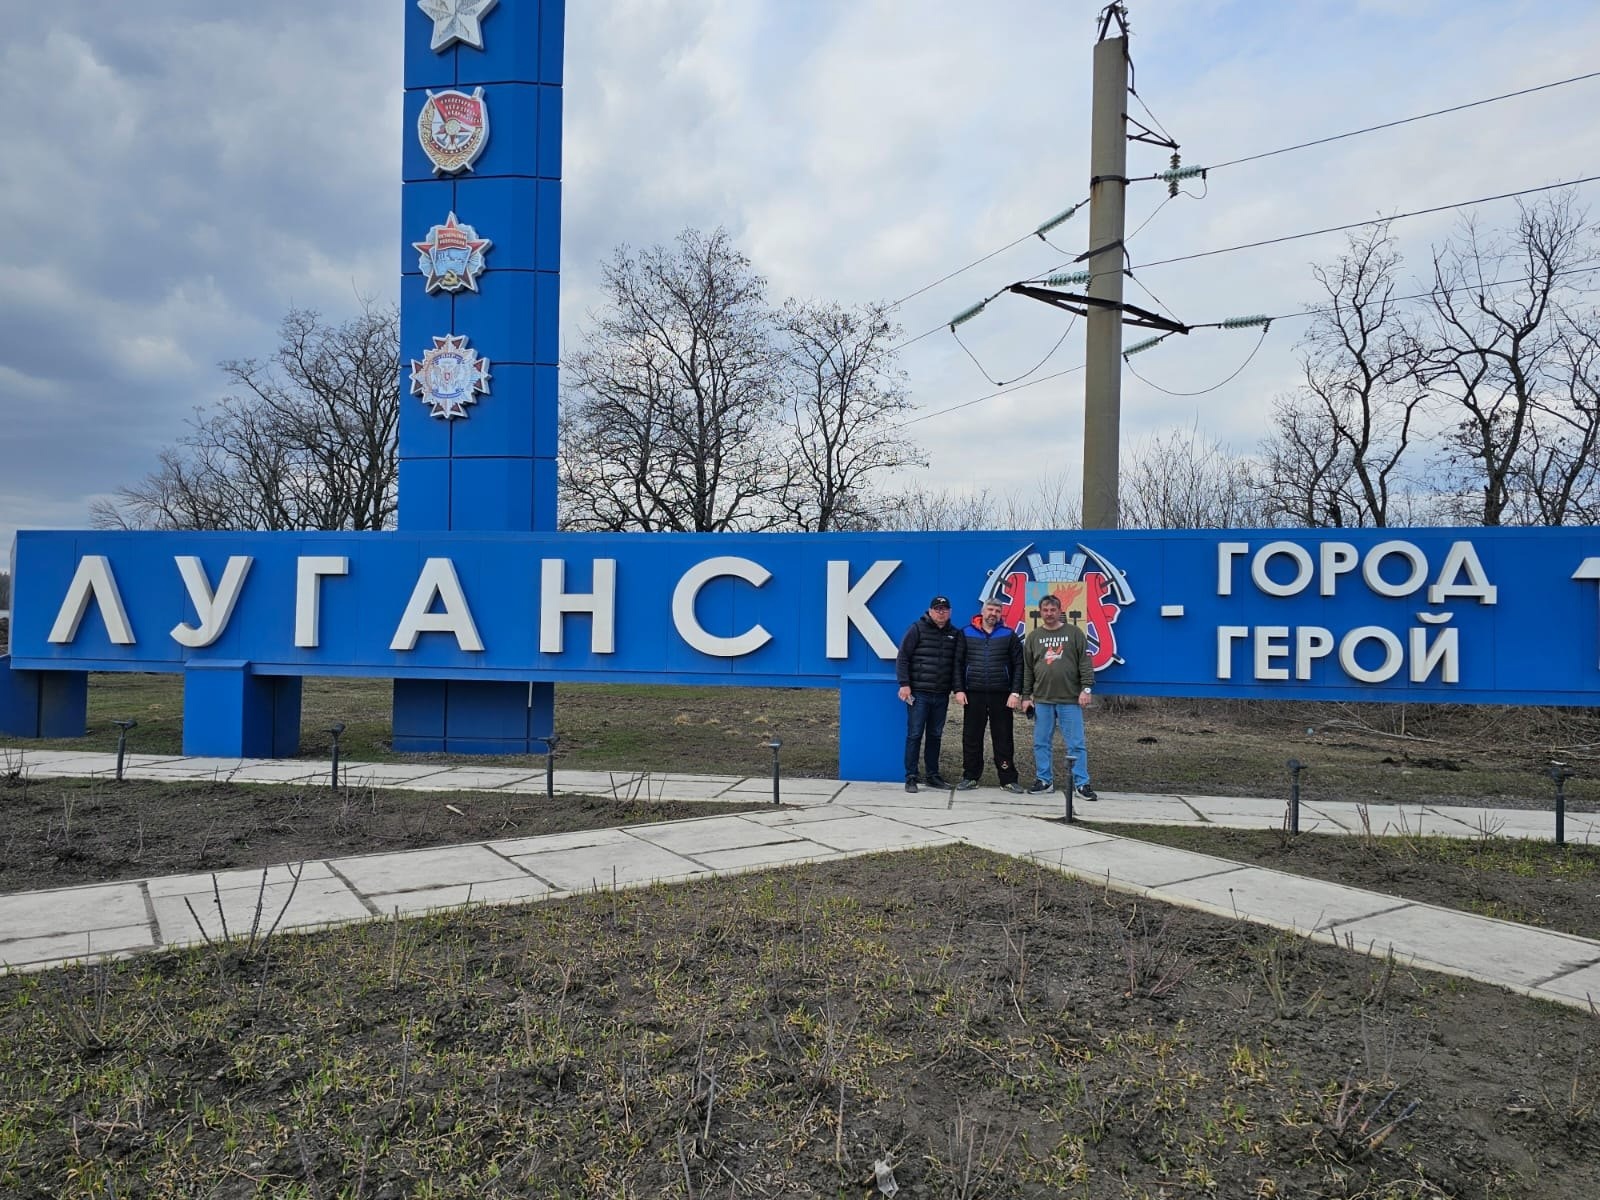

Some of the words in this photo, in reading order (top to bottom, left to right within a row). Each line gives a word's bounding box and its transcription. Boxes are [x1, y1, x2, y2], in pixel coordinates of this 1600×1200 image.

[47, 555, 902, 659] ЛУГАНСК
[1217, 540, 1498, 605] ГОРОД
[1217, 612, 1460, 683] ГЕРОЙ
